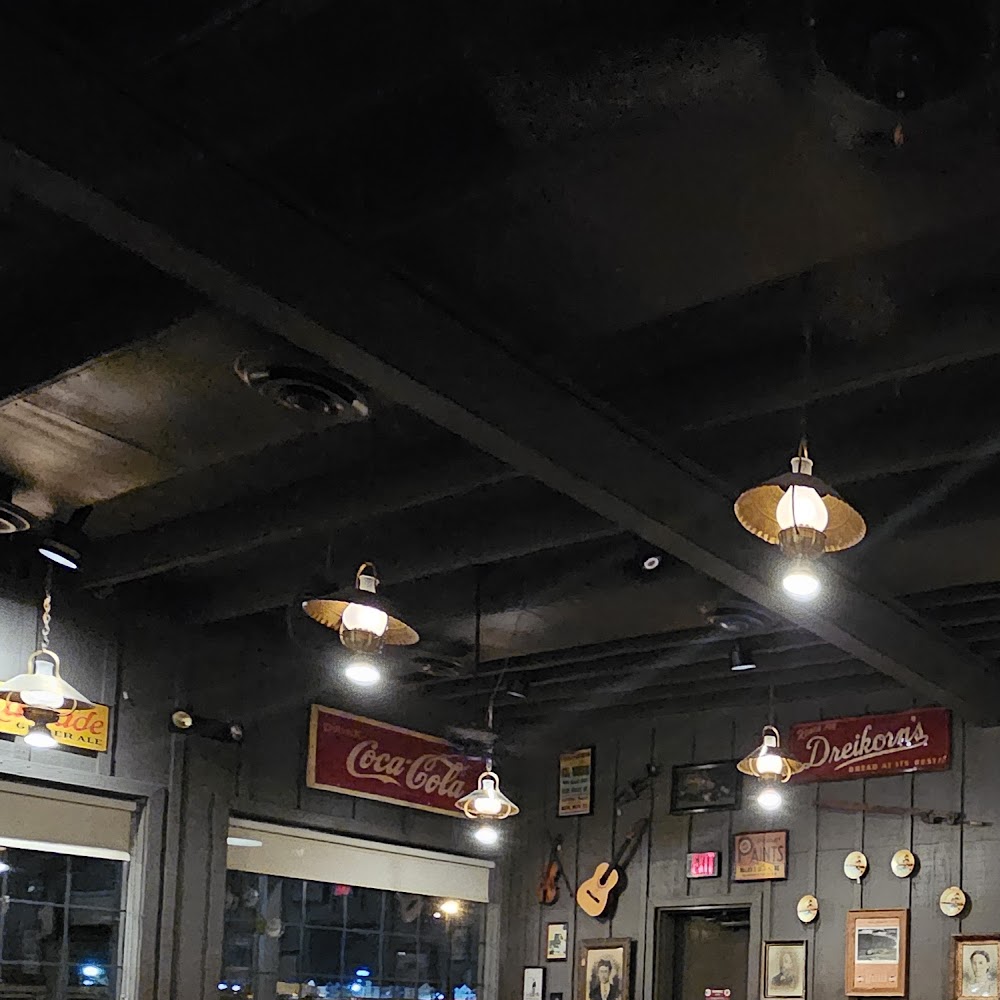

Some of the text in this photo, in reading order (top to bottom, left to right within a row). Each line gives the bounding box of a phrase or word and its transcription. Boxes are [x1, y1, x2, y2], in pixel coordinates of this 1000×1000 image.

[79, 735, 103, 745] ALE
[802, 716, 929, 770] Dreikorn's
[346, 740, 465, 798] Coca-Cola
[738, 836, 784, 864] PAINTS
